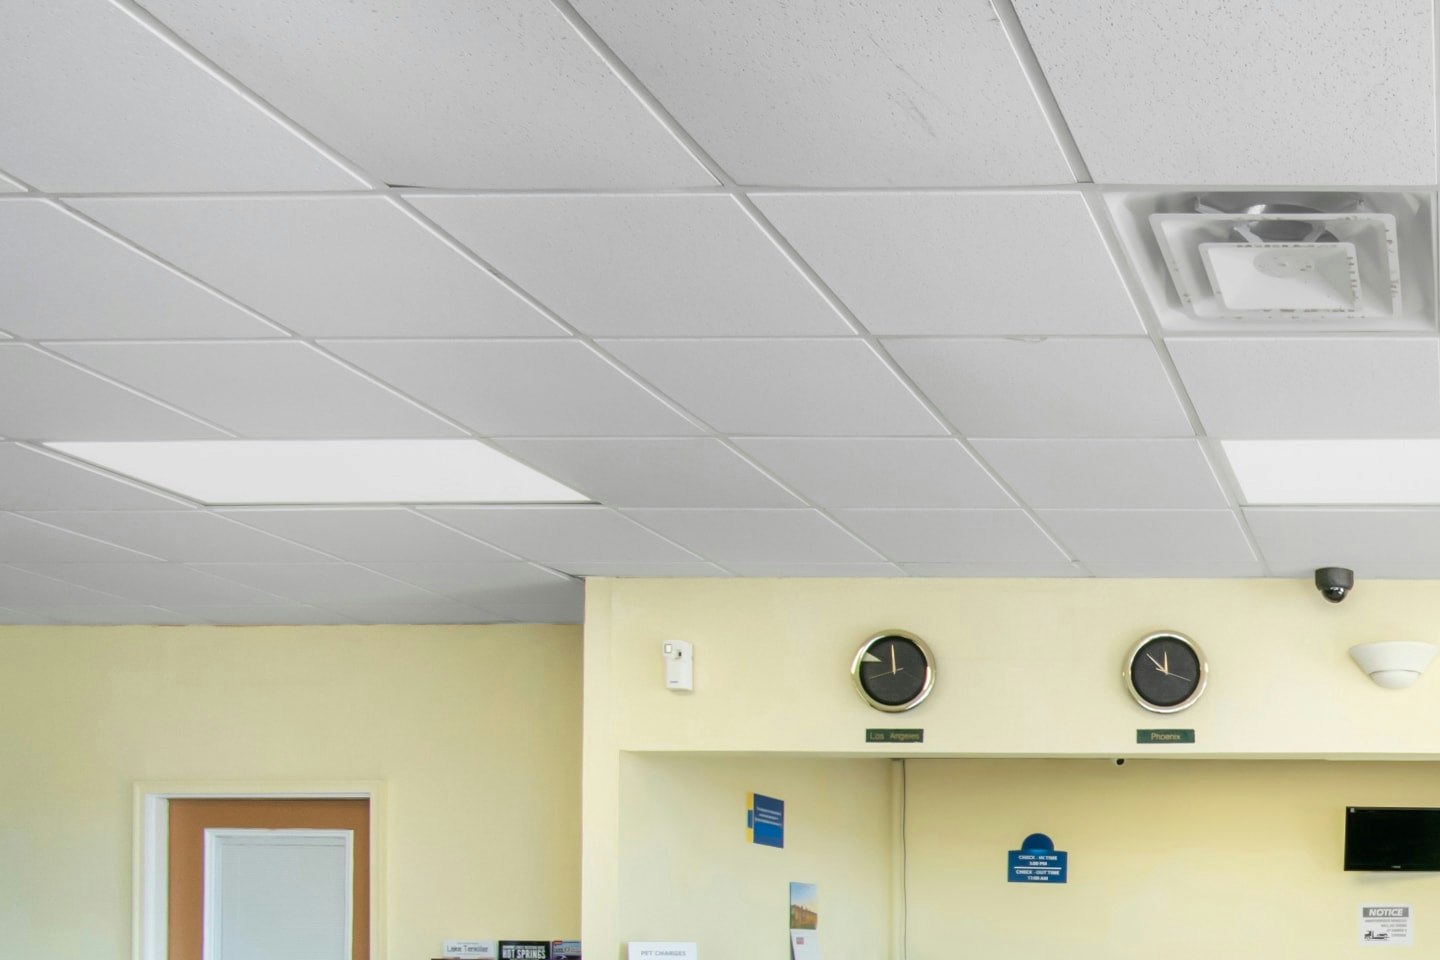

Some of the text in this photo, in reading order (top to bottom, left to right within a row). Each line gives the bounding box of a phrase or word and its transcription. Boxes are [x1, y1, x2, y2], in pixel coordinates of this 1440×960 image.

[870, 732, 885, 740] Los
[1150, 732, 1181, 741] Phoenix
[1368, 908, 1404, 917] NOTICE
[516, 949, 546, 960] SPRINGS
